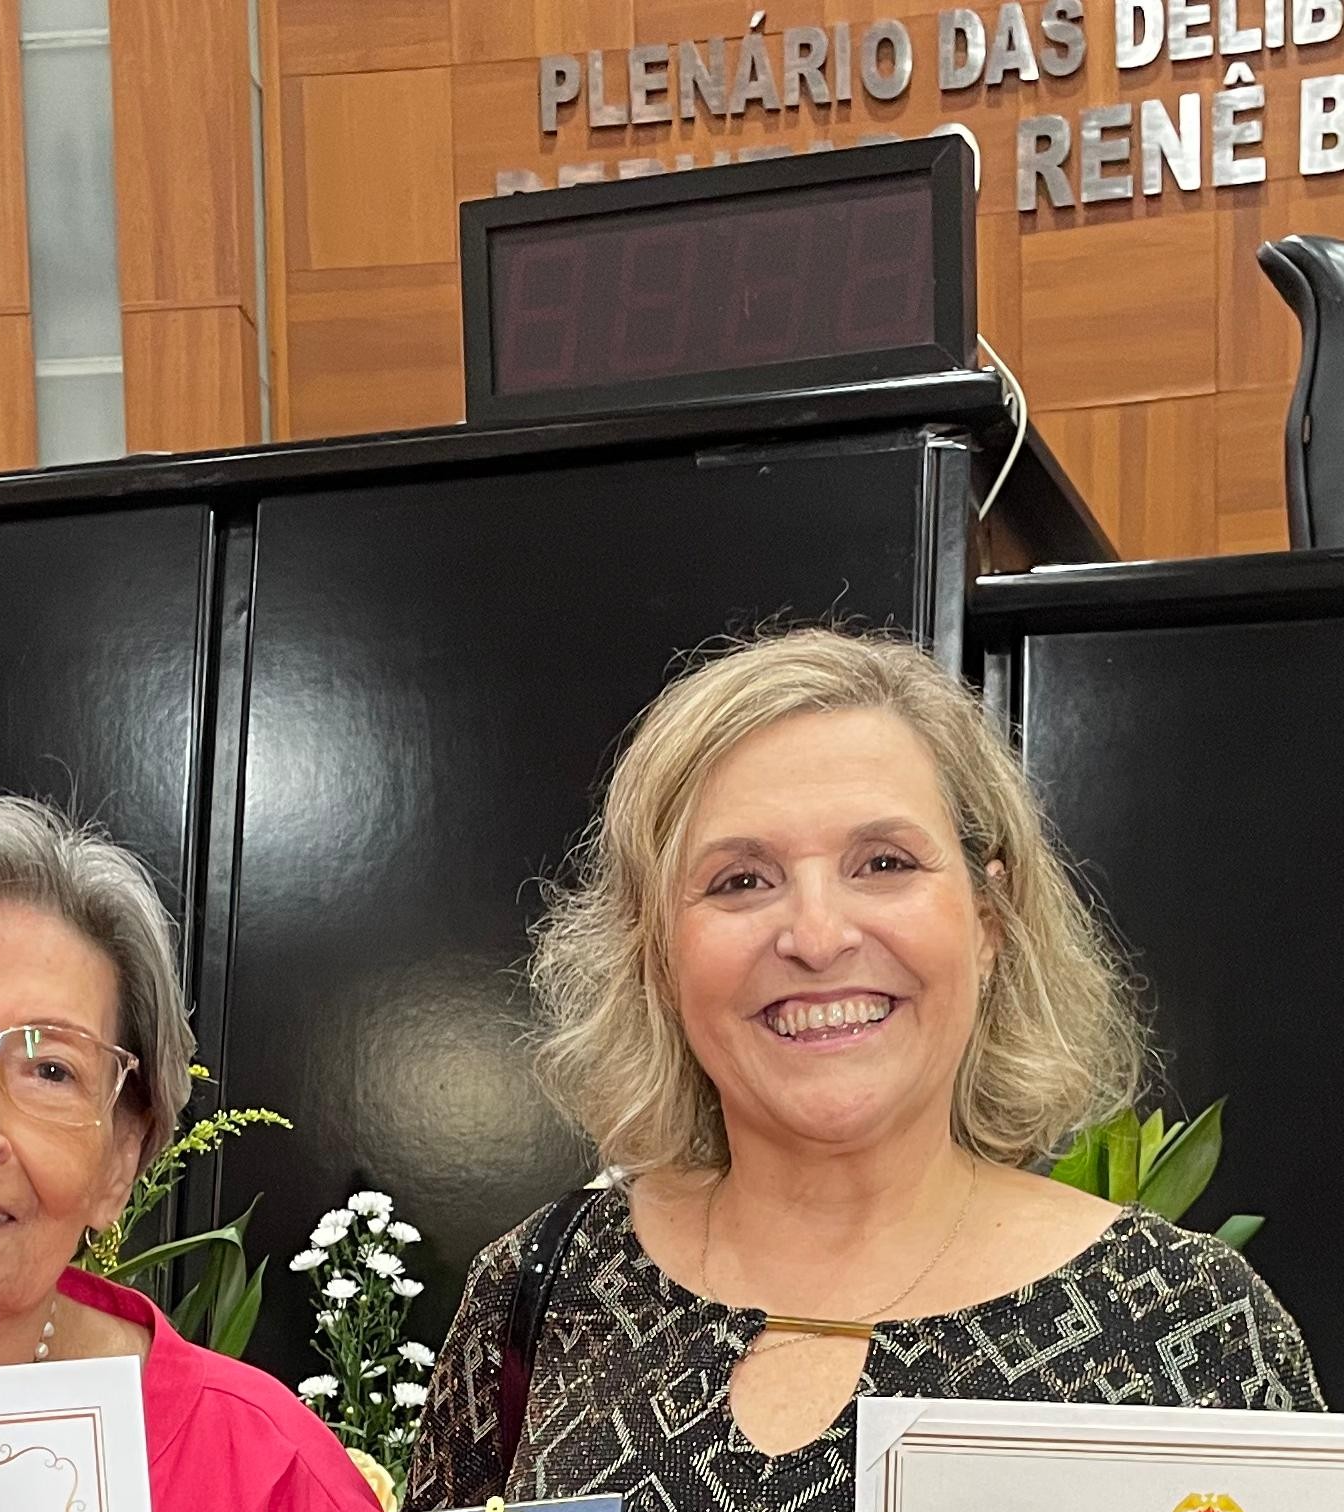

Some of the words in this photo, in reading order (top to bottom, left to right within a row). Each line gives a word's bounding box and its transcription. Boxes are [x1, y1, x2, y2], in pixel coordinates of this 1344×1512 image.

[540, 11, 913, 132] PLENÁRIO
[938, 0, 1087, 92] DAS
[1017, 62, 1266, 212] RENÊ
